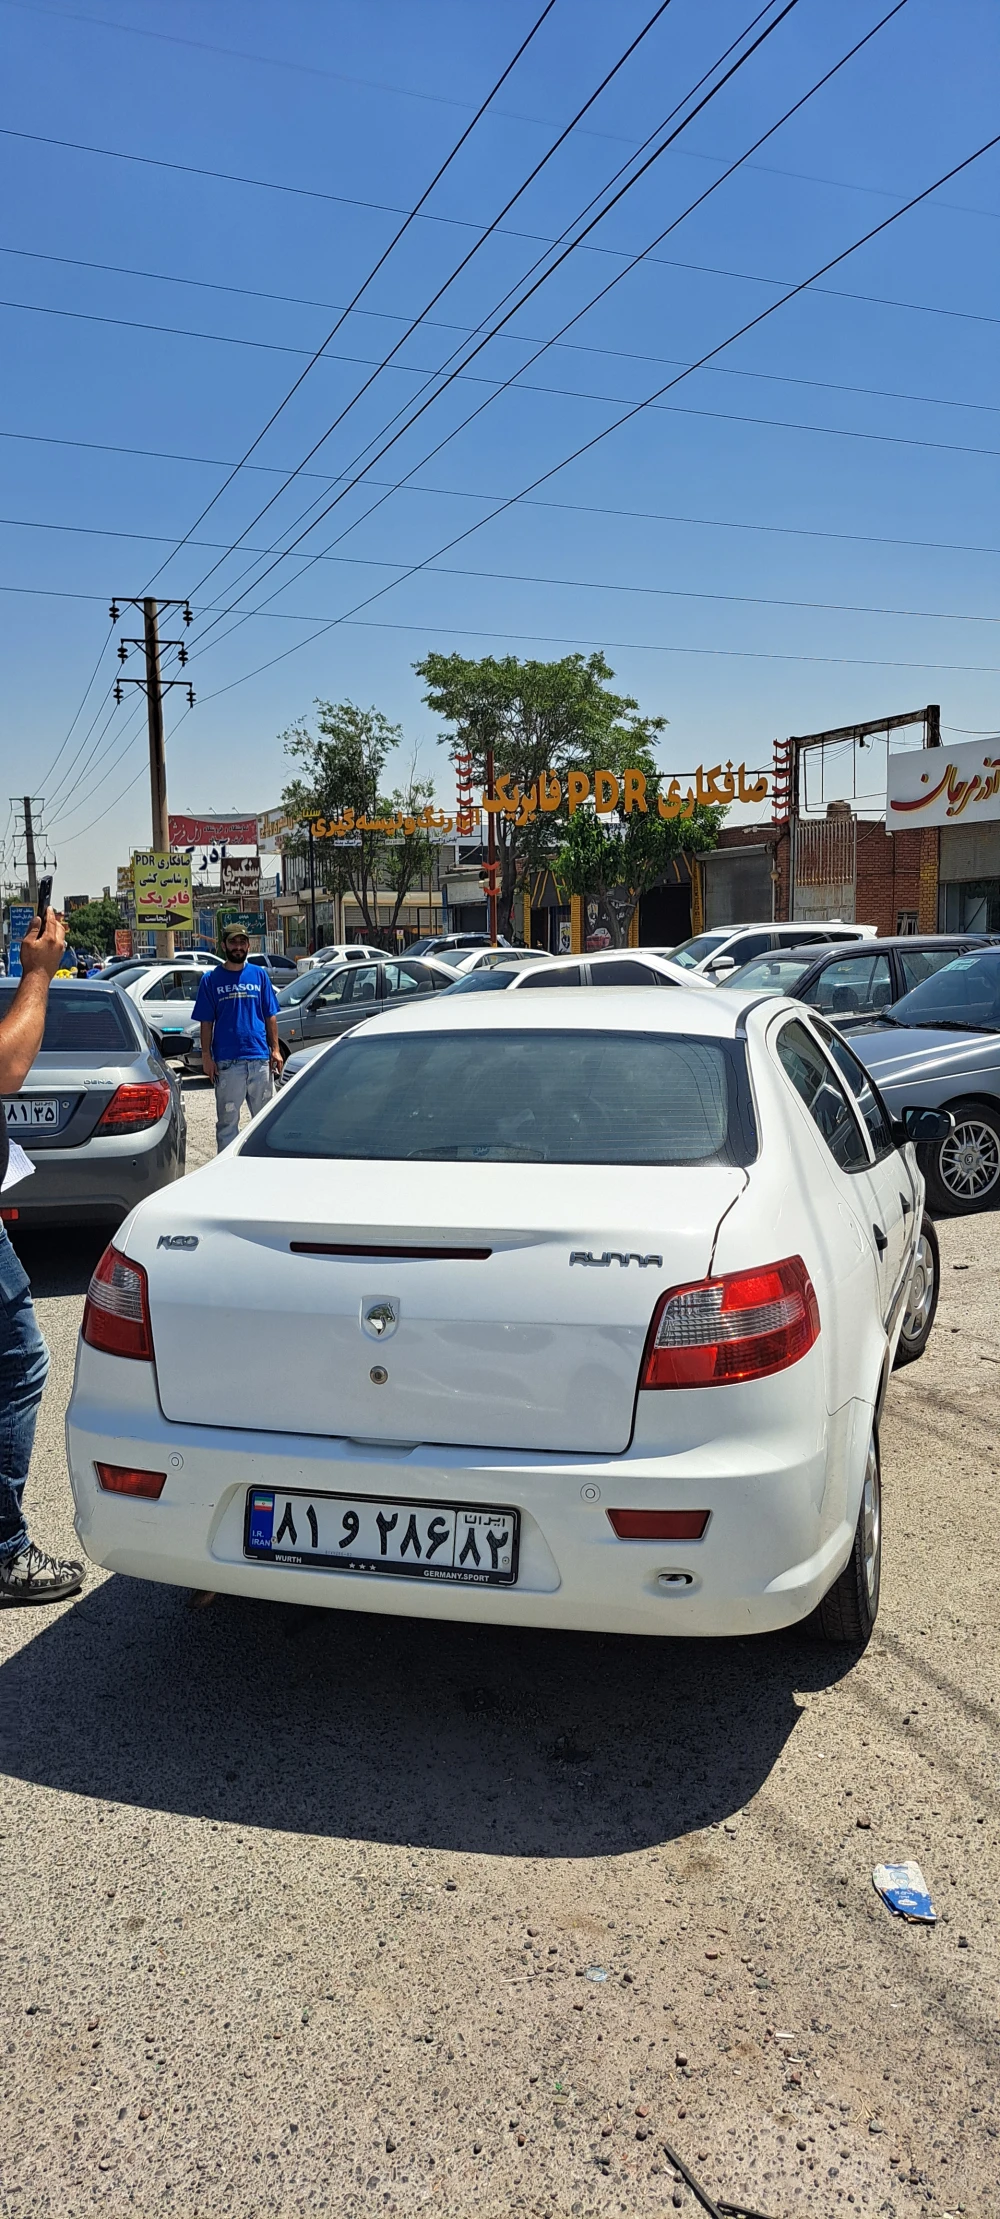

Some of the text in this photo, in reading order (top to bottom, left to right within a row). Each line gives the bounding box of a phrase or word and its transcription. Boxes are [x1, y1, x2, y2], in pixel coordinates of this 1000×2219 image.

[568, 769, 648, 815] PDR
[658, 758, 769, 819] صافکاری
[482, 768, 561, 826] فابریک
[418, 806, 453, 833] رنگ
[136, 854, 190, 870] صافکاری PDR
[140, 873, 158, 887] کشی
[160, 873, 182, 887] شاسی
[183, 878, 189, 887] و
[139, 890, 190, 909] فابریک
[144, 914, 172, 924] اینجاست
[216, 983, 261, 995] REASON
[464, 1514, 506, 1528] ایران
[252, 1529, 265, 1538] I.R.
[276, 1502, 450, 1560] ۸۱ و ۲۸۶
[251, 1537, 271, 1547] IRAN
[458, 1527, 509, 1570] ۸۲
[274, 1553, 303, 1564] WURTH
[423, 1569, 490, 1583] GERMANY.SPORT
